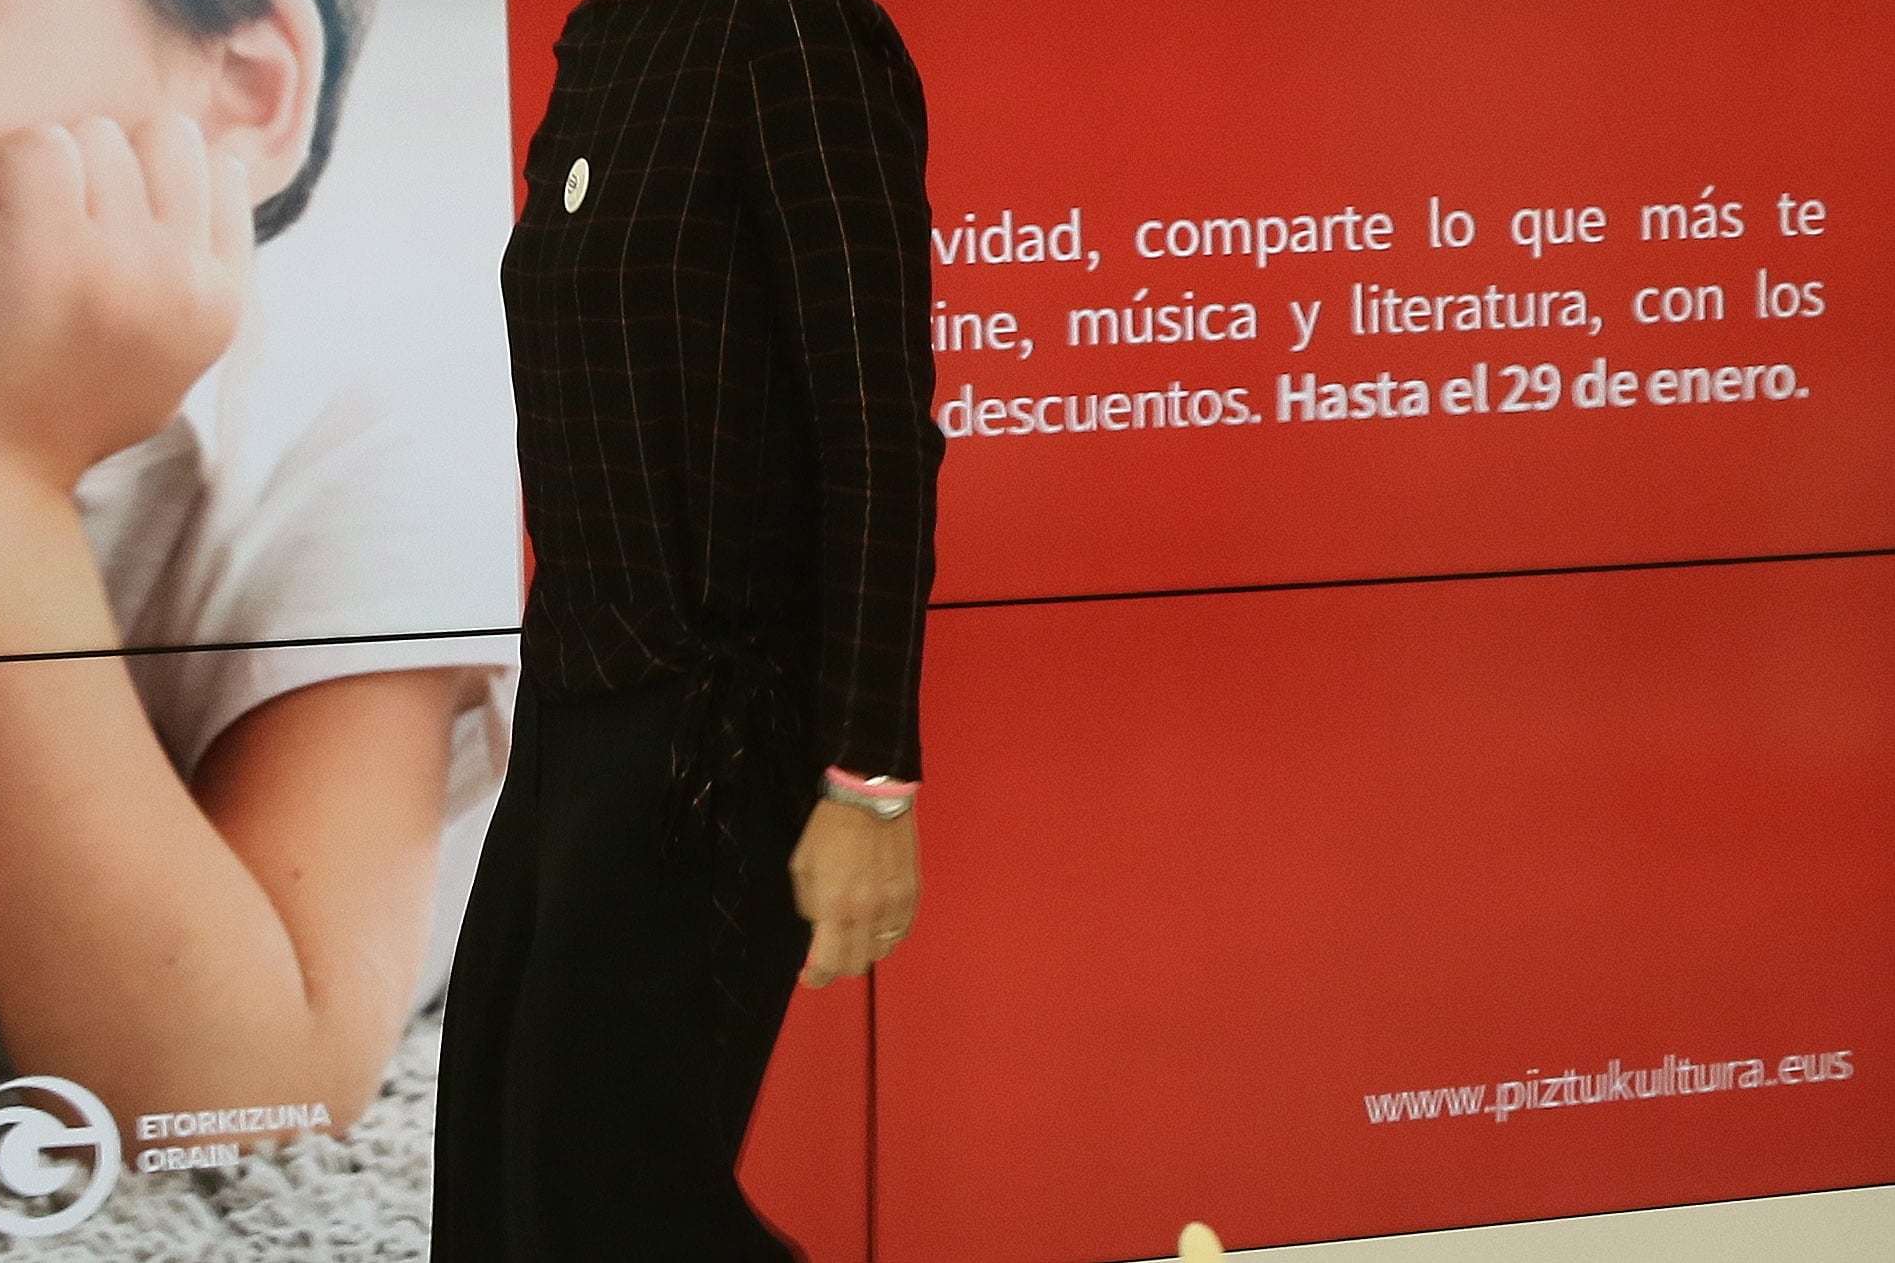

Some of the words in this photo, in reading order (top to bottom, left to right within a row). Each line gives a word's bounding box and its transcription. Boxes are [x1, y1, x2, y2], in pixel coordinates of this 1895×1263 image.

[930, 206, 1102, 272] vidad,
[1133, 205, 1395, 267] comparte
[1428, 195, 1477, 249] lo
[1509, 205, 1608, 258] que
[1640, 183, 1746, 242] más
[1775, 191, 1827, 238] te
[928, 299, 1035, 361] ine,
[1067, 286, 1258, 348] música
[1288, 299, 1323, 352] y
[1350, 281, 1604, 338] literatura,
[1632, 284, 1725, 325] con
[1755, 267, 1826, 320] los
[940, 379, 1263, 440] descuentos.
[1275, 370, 1431, 424] Hasta
[1438, 361, 1492, 416] el
[1496, 362, 1563, 414] 29
[1570, 356, 1640, 410] de
[1644, 363, 1811, 407] enero.
[136, 1102, 332, 1141] ETORKIZUNA
[1362, 1049, 1855, 1125] www.piztukultura.eus
[136, 1142, 240, 1174] ORAIN
